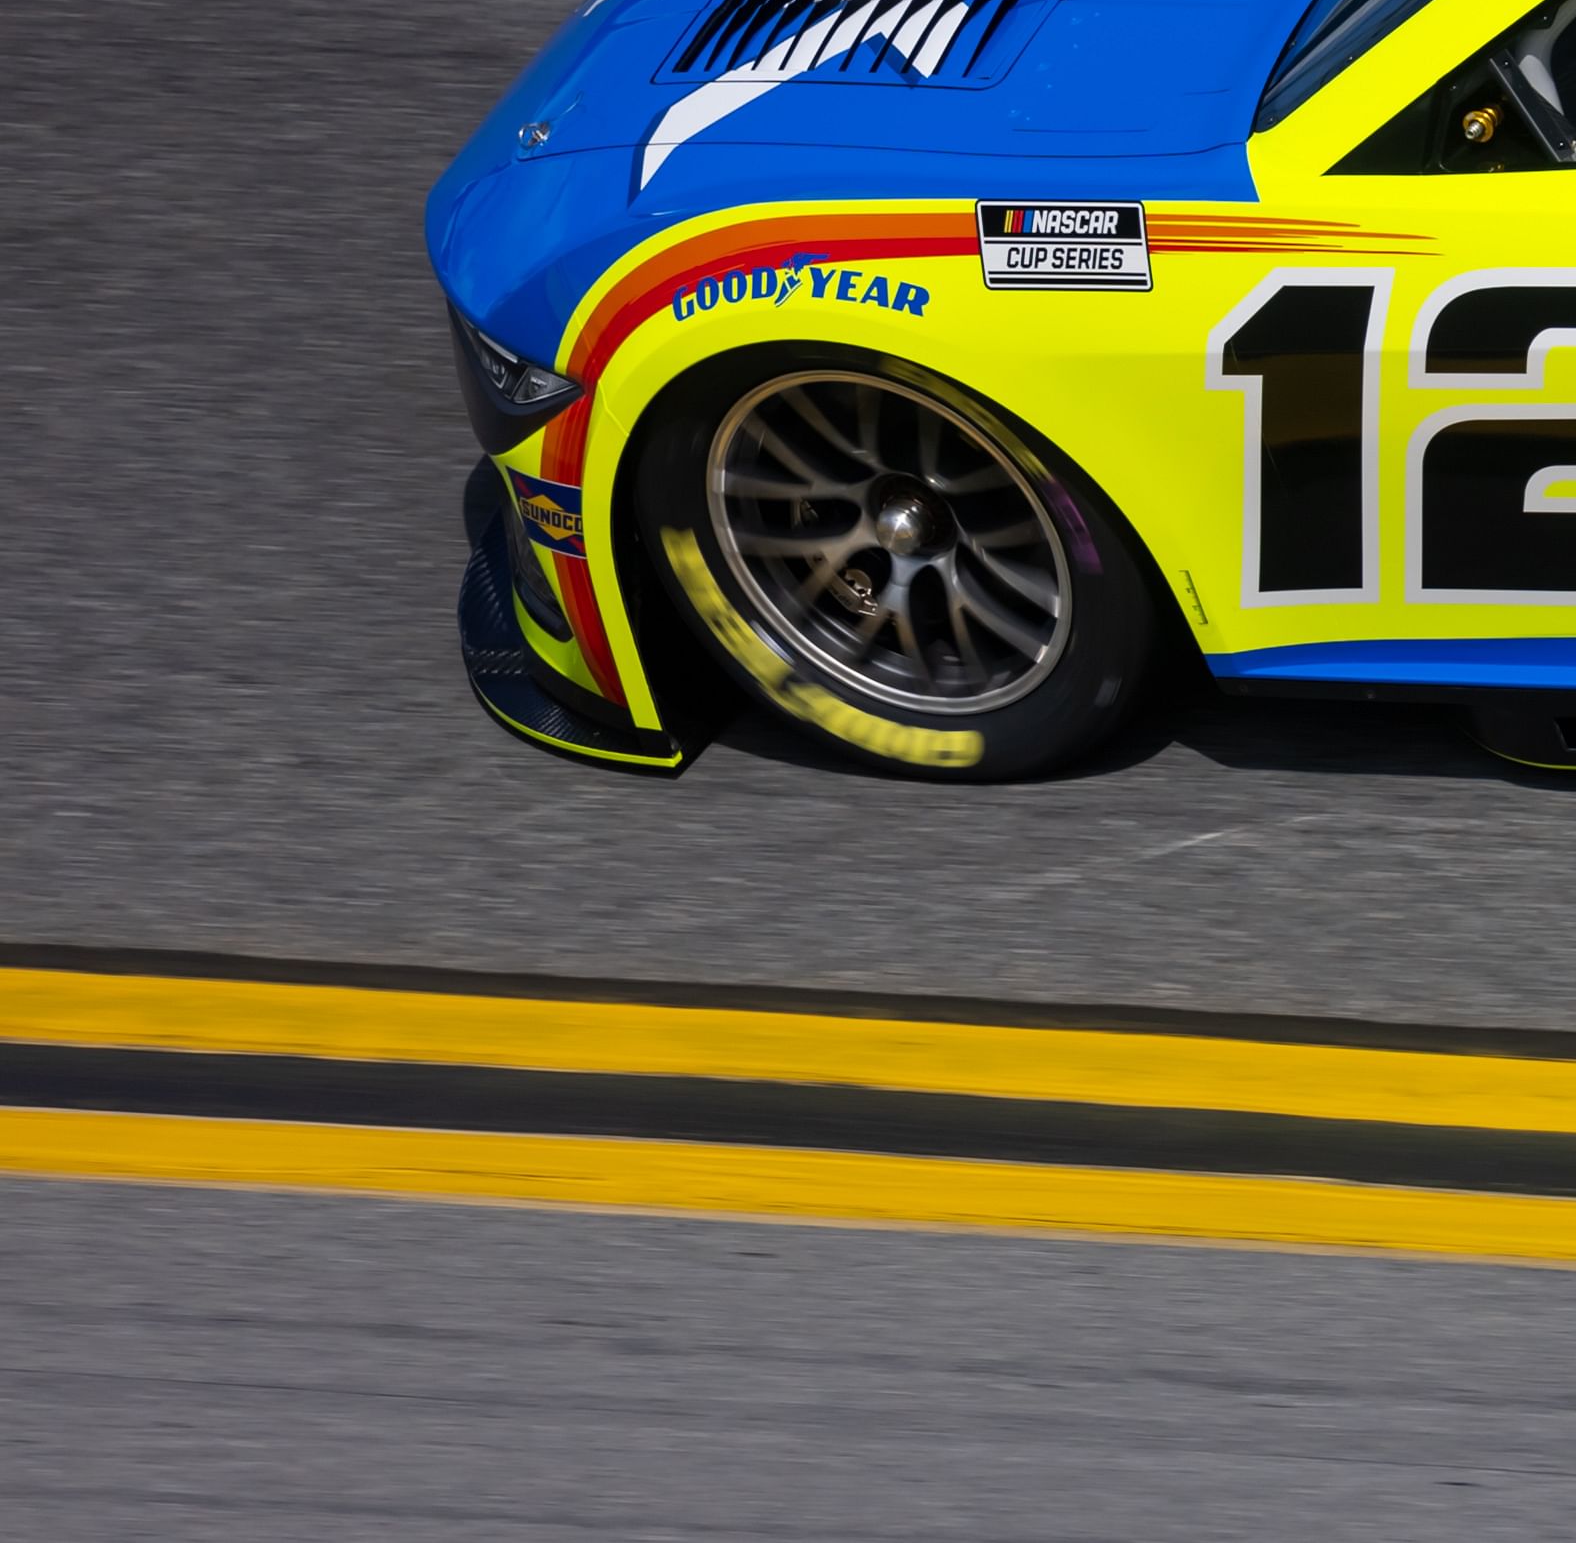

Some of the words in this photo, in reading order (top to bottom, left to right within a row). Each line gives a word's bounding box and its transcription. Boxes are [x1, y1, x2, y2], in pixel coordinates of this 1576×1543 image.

[1031, 209, 1119, 235] NASCAR
[1006, 247, 1050, 269] CUP
[1051, 247, 1125, 271] SERIES
